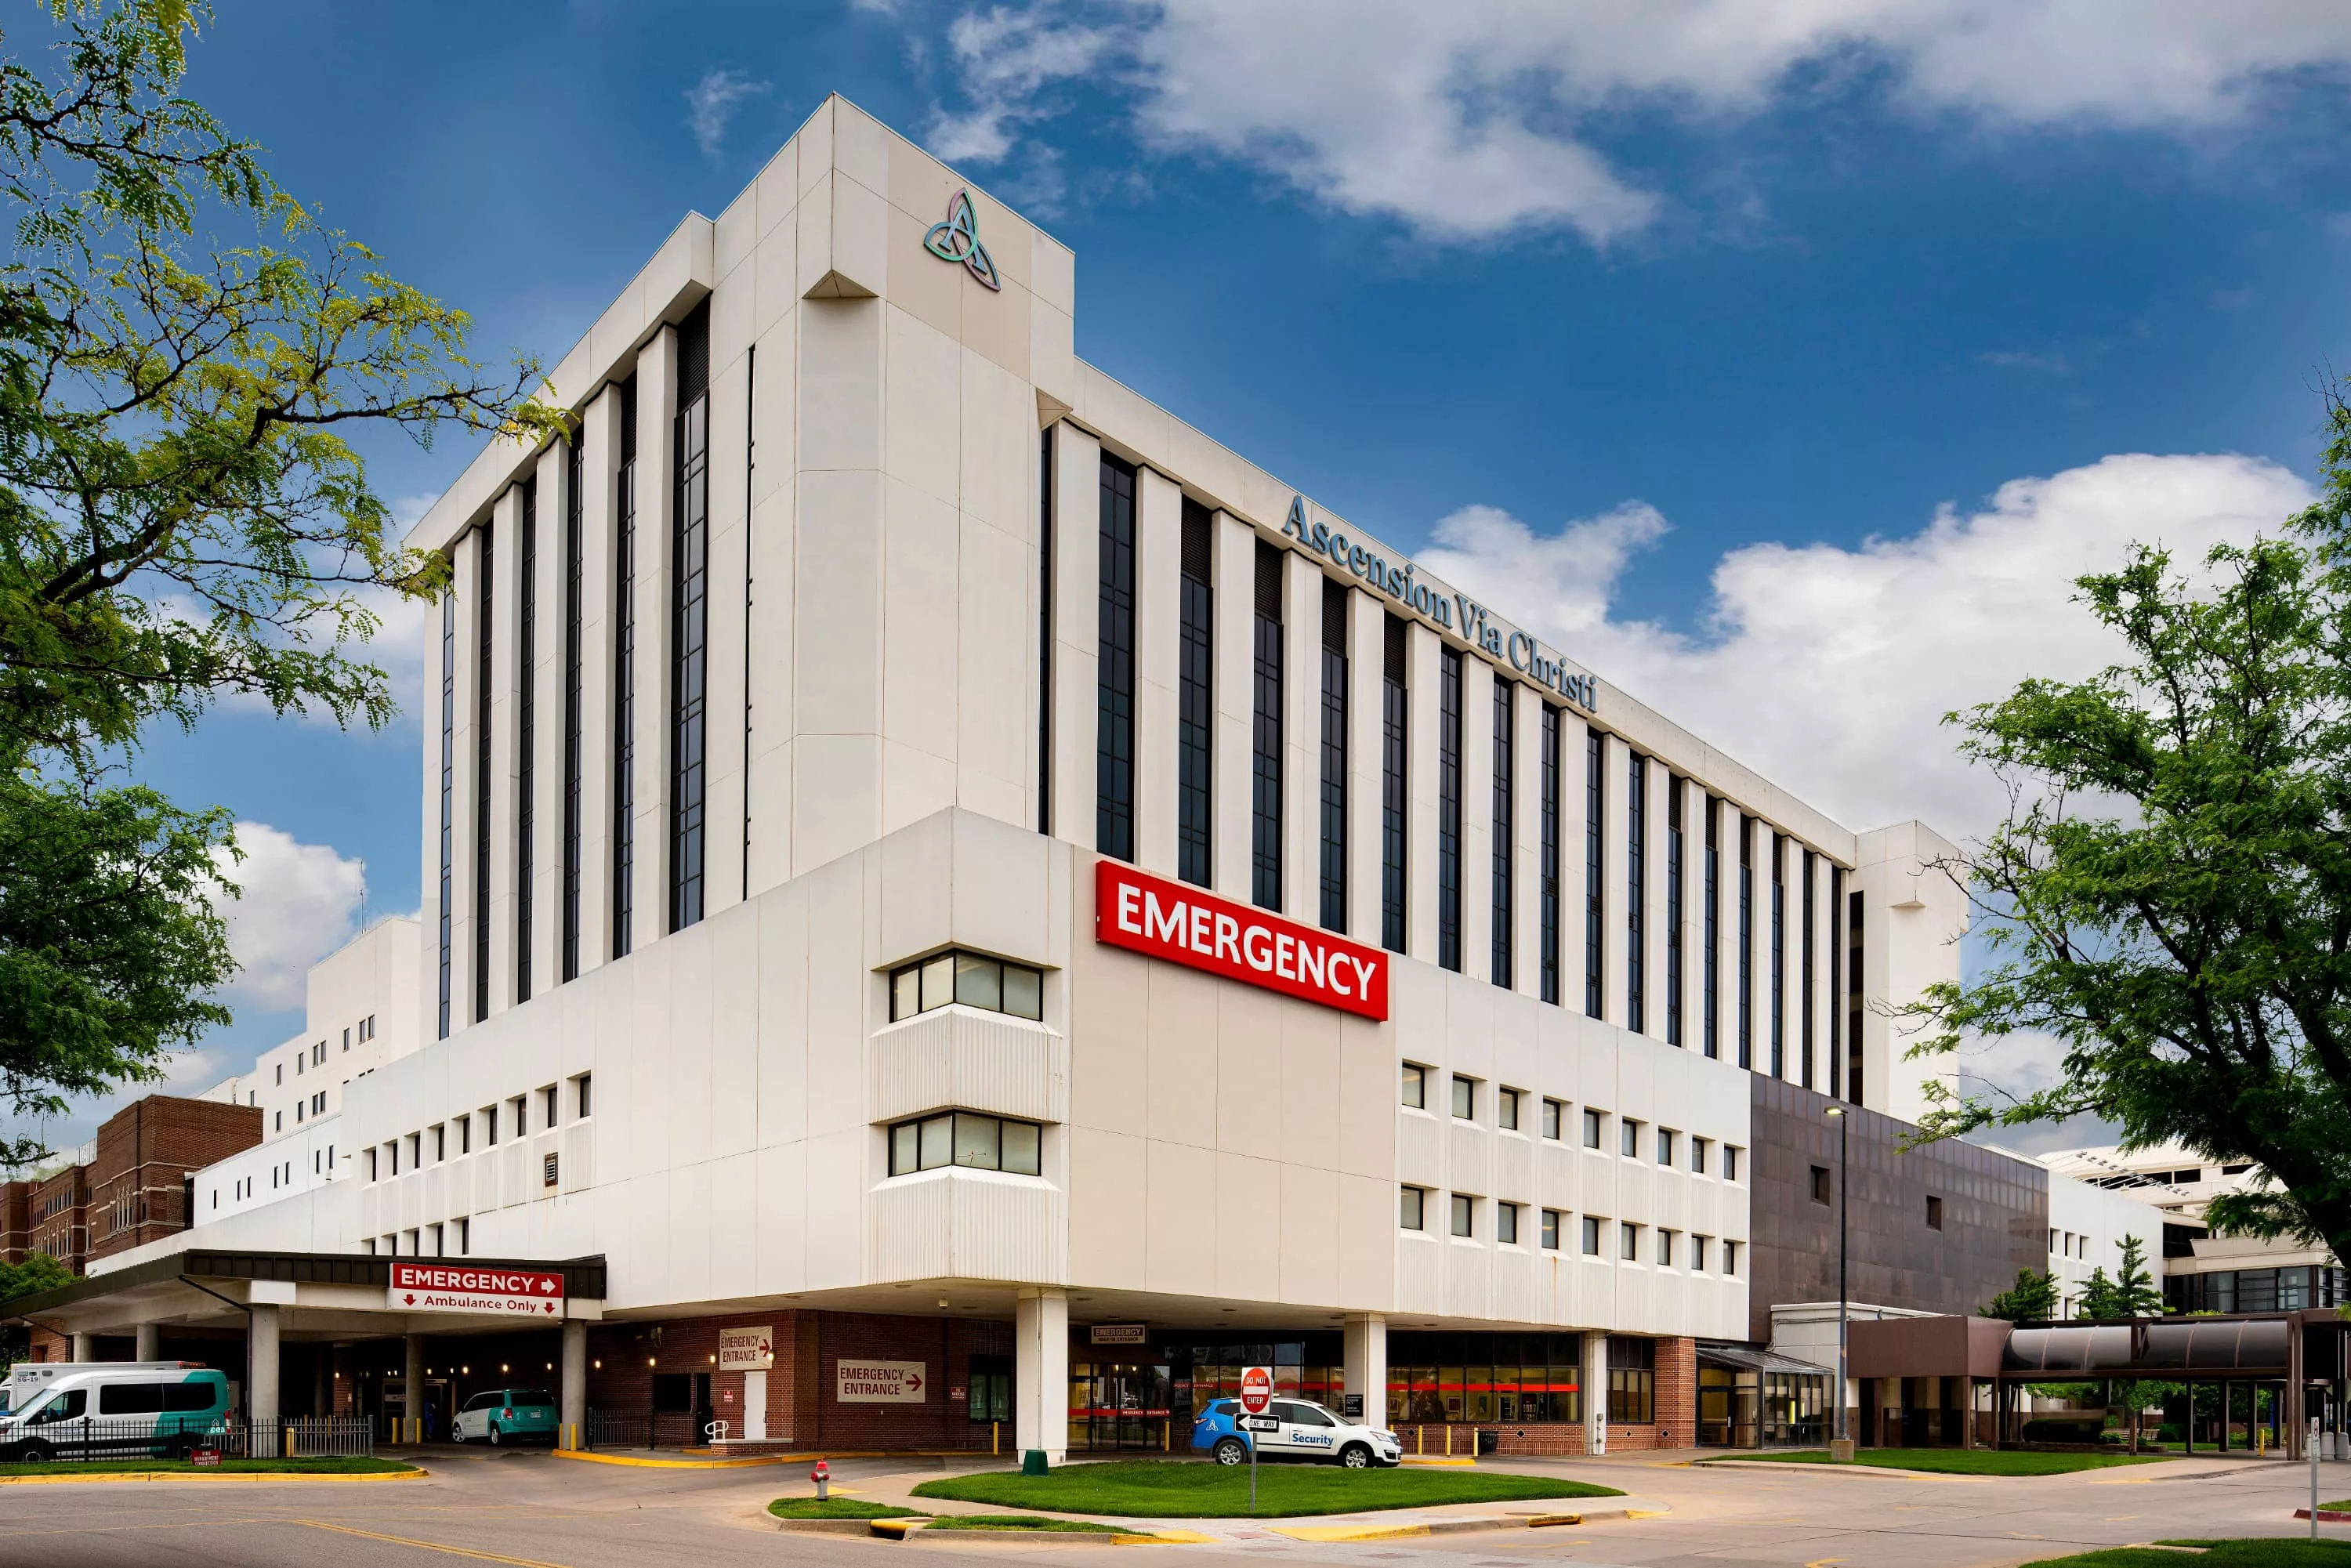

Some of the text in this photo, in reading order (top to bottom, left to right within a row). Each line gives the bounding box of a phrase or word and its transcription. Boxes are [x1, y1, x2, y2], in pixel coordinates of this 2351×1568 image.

[1281, 494, 1598, 713] Ascension Via Christi
[1118, 882, 1377, 1001] EMERGENCY
[400, 1268, 534, 1292] EMERGENCY
[424, 1295, 537, 1313] Ambulance Only
[721, 1335, 759, 1348] EMERGENCY
[723, 1350, 756, 1362] ENTRANCE
[840, 1367, 904, 1381] EMERGENCY
[844, 1383, 900, 1395] ENTRANCE
[1248, 1419, 1261, 1428] ONE
[1292, 1433, 1334, 1446] Security
